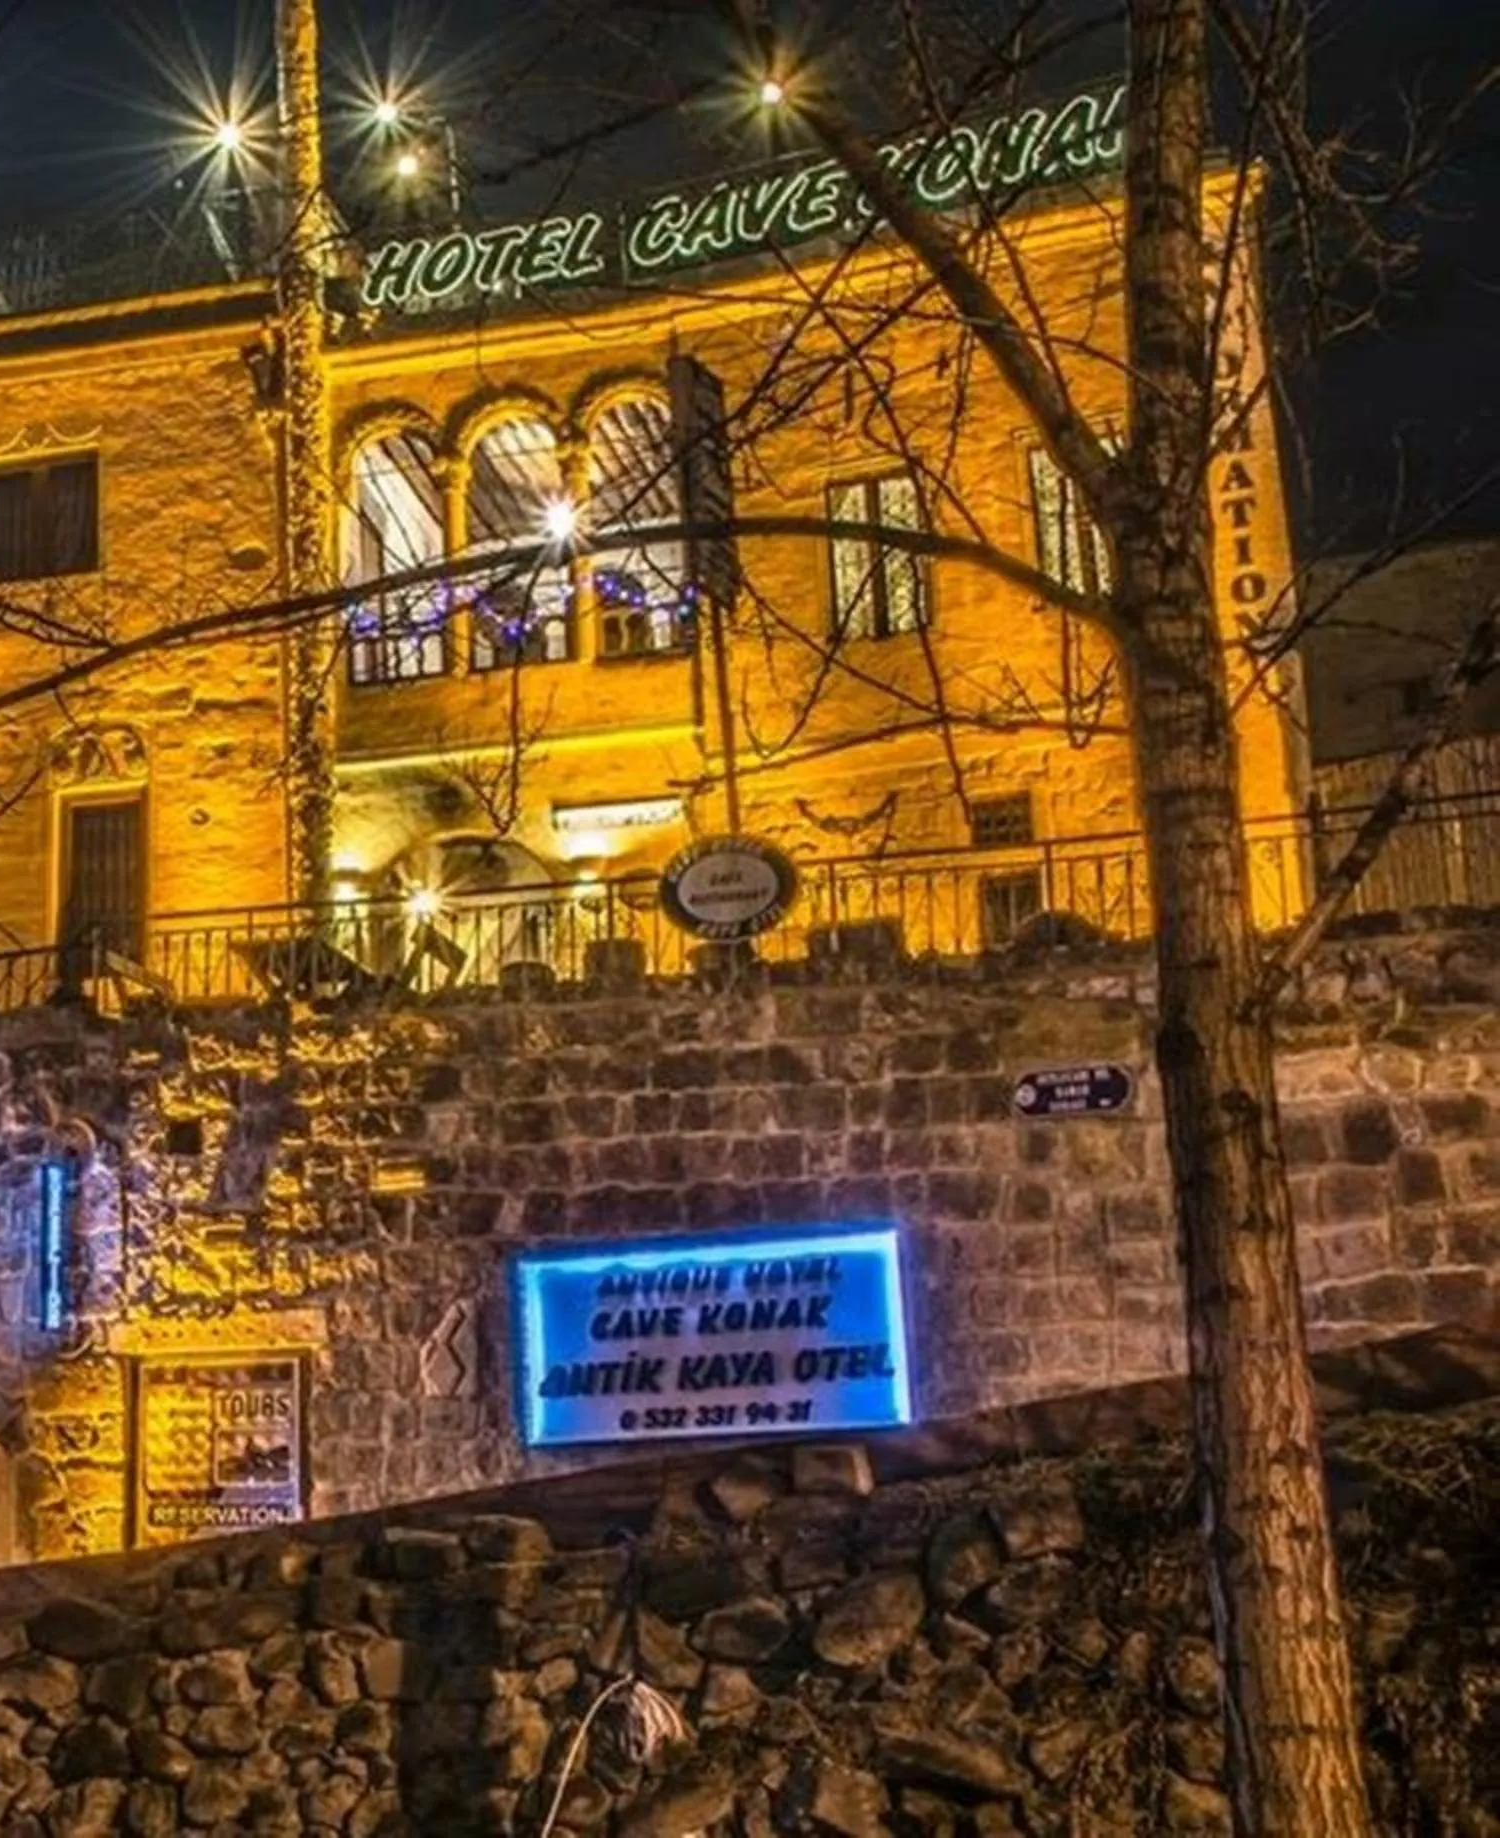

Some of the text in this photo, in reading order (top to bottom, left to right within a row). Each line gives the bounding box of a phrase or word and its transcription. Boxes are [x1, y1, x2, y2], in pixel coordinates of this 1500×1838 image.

[363, 213, 604, 306] HOTEL
[630, 170, 846, 267] CAVE
[590, 1295, 833, 1342] CAVE KONAK
[677, 1350, 776, 1391] KAYA
[791, 1344, 896, 1382] OTEL
[216, 1393, 291, 1416] TOURS
[643, 1406, 687, 1430] 532
[694, 1403, 738, 1427] 331
[746, 1402, 781, 1425] 94
[787, 1400, 814, 1422] 31
[152, 1502, 288, 1527] RESERVATION
